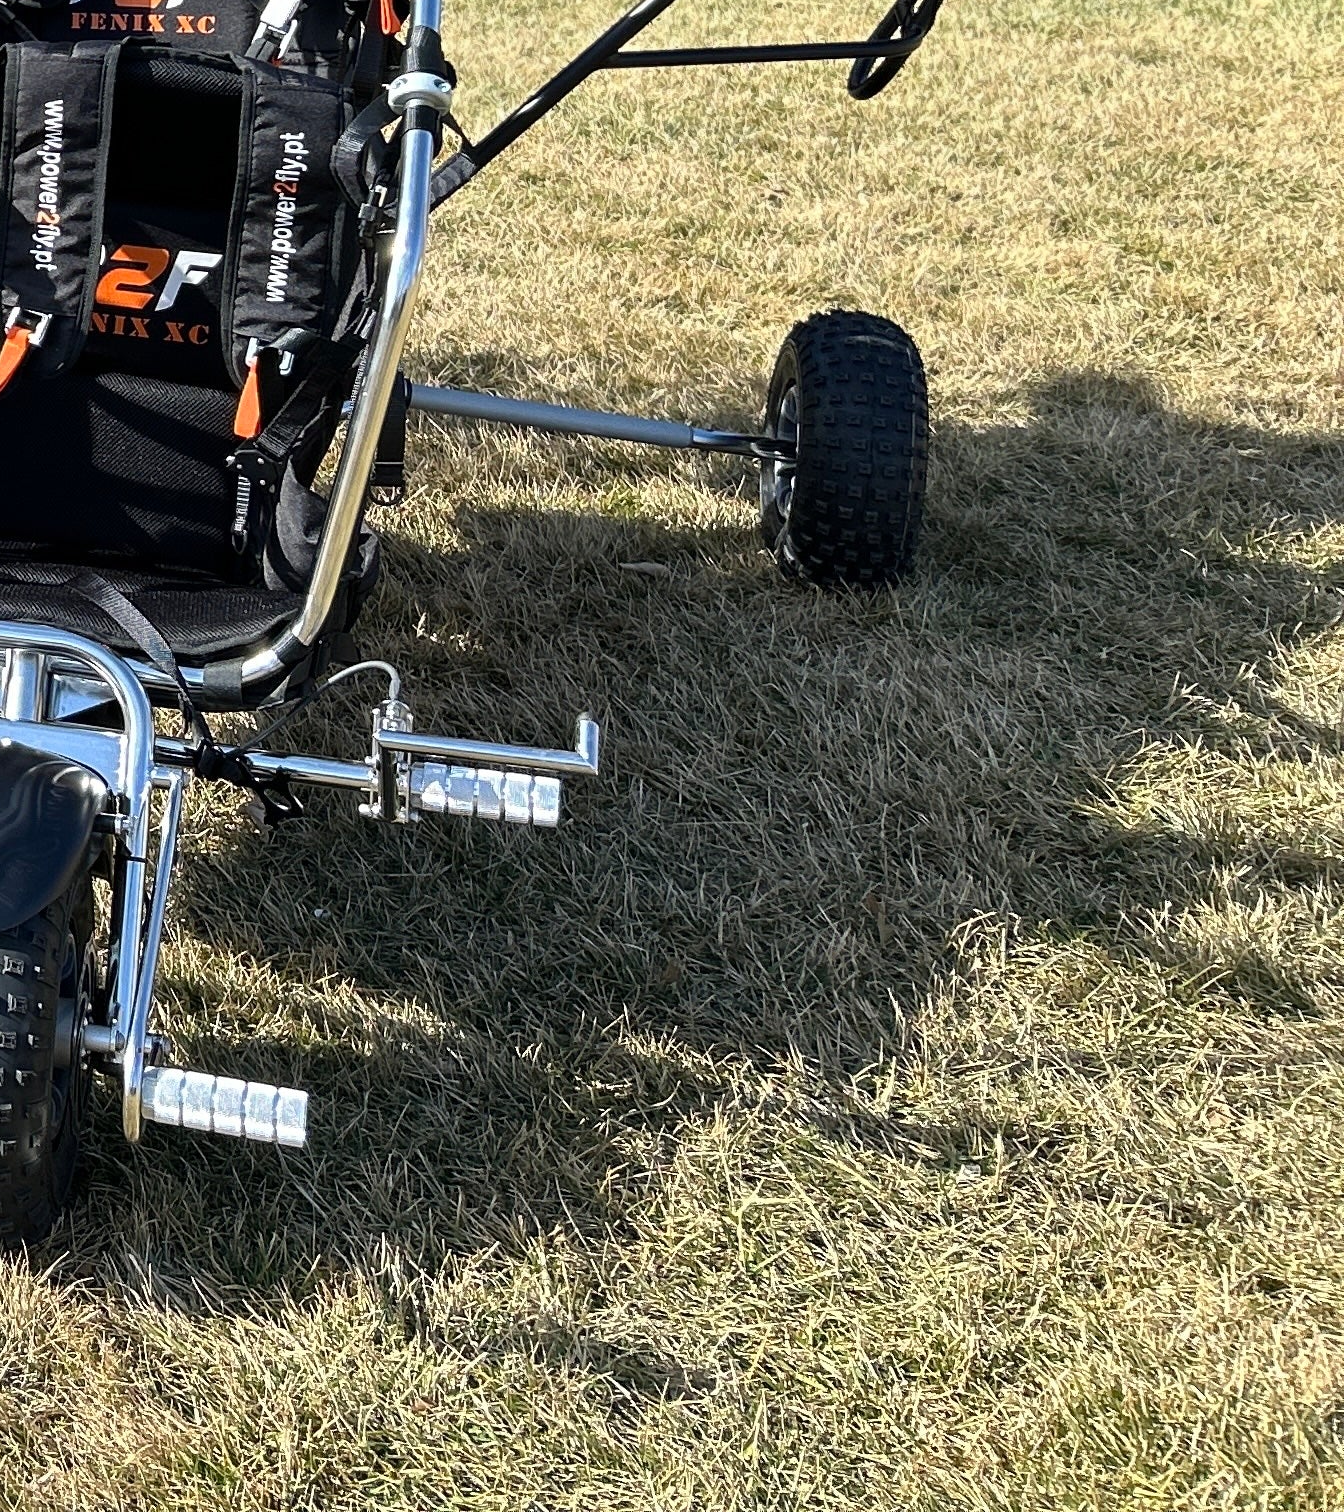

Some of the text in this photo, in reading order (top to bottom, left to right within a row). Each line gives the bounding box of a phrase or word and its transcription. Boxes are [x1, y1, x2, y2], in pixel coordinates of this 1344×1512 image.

[70, 12, 217, 35] FENIX XC
[29, 99, 65, 272] www.power2fly.pt
[265, 131, 310, 303] www.power2fly.pt
[95, 244, 224, 312] 2F
[88, 312, 210, 345] NIX XC
